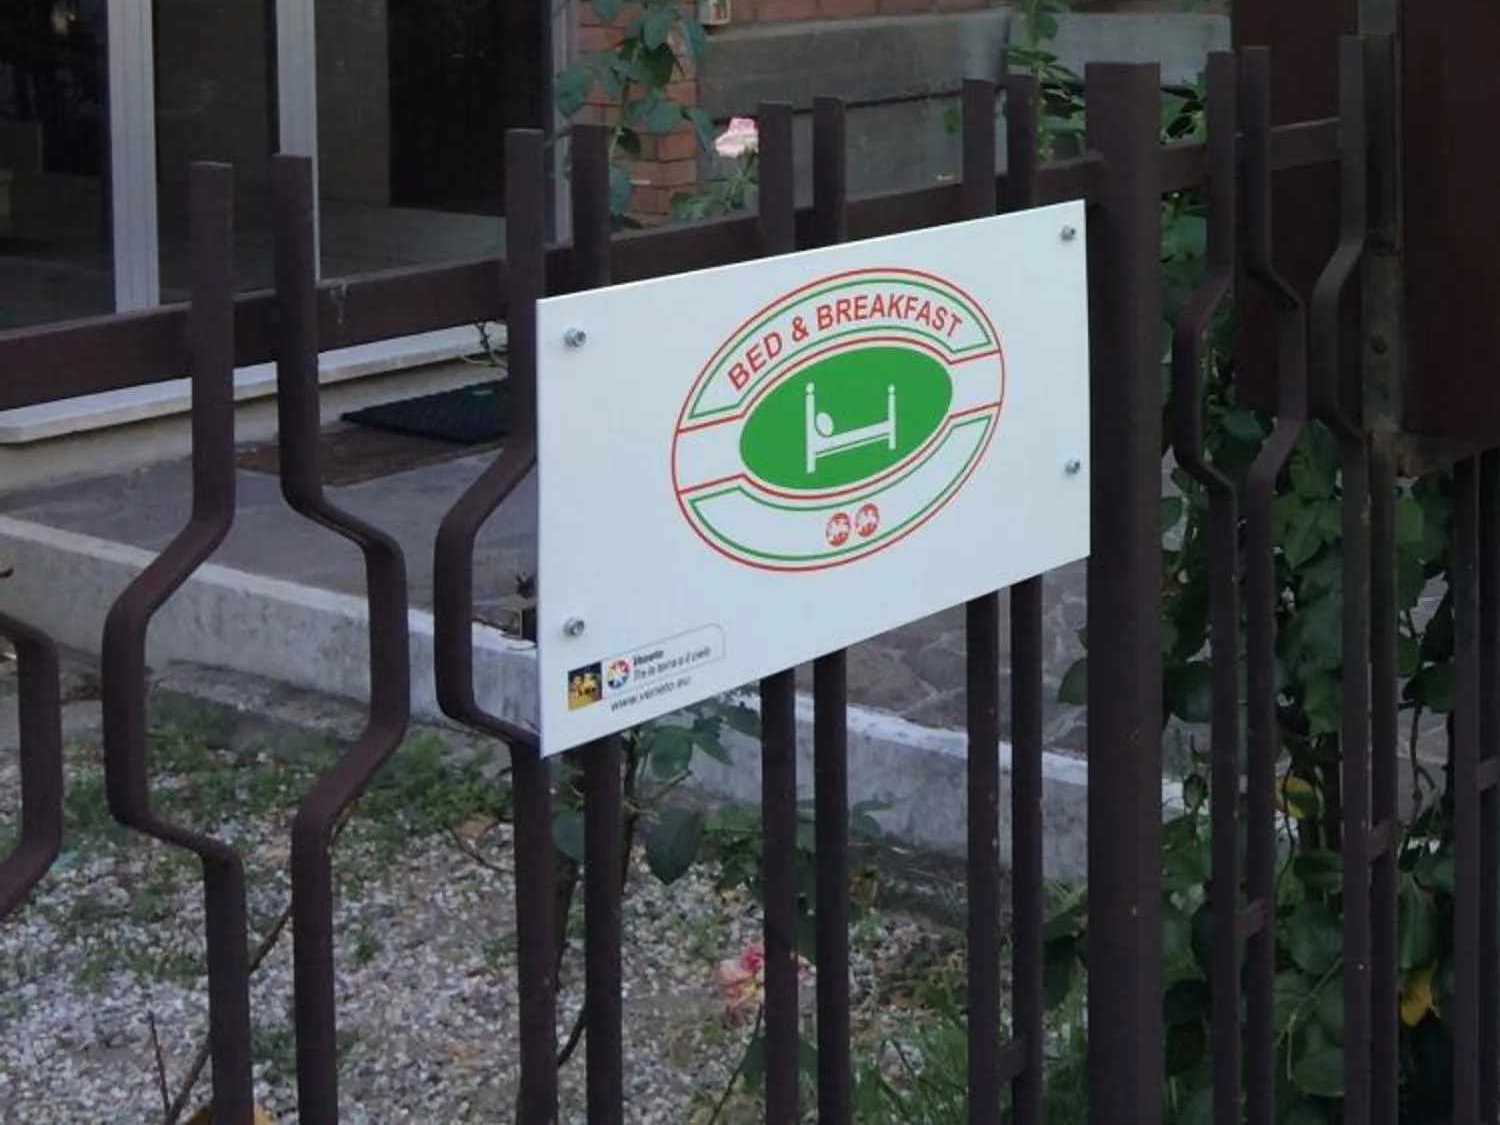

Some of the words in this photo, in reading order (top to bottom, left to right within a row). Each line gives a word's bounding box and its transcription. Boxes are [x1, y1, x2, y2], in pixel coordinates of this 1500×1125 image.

[728, 332, 783, 391] BED
[791, 316, 810, 342] &
[815, 293, 963, 337] BREAKFAST
